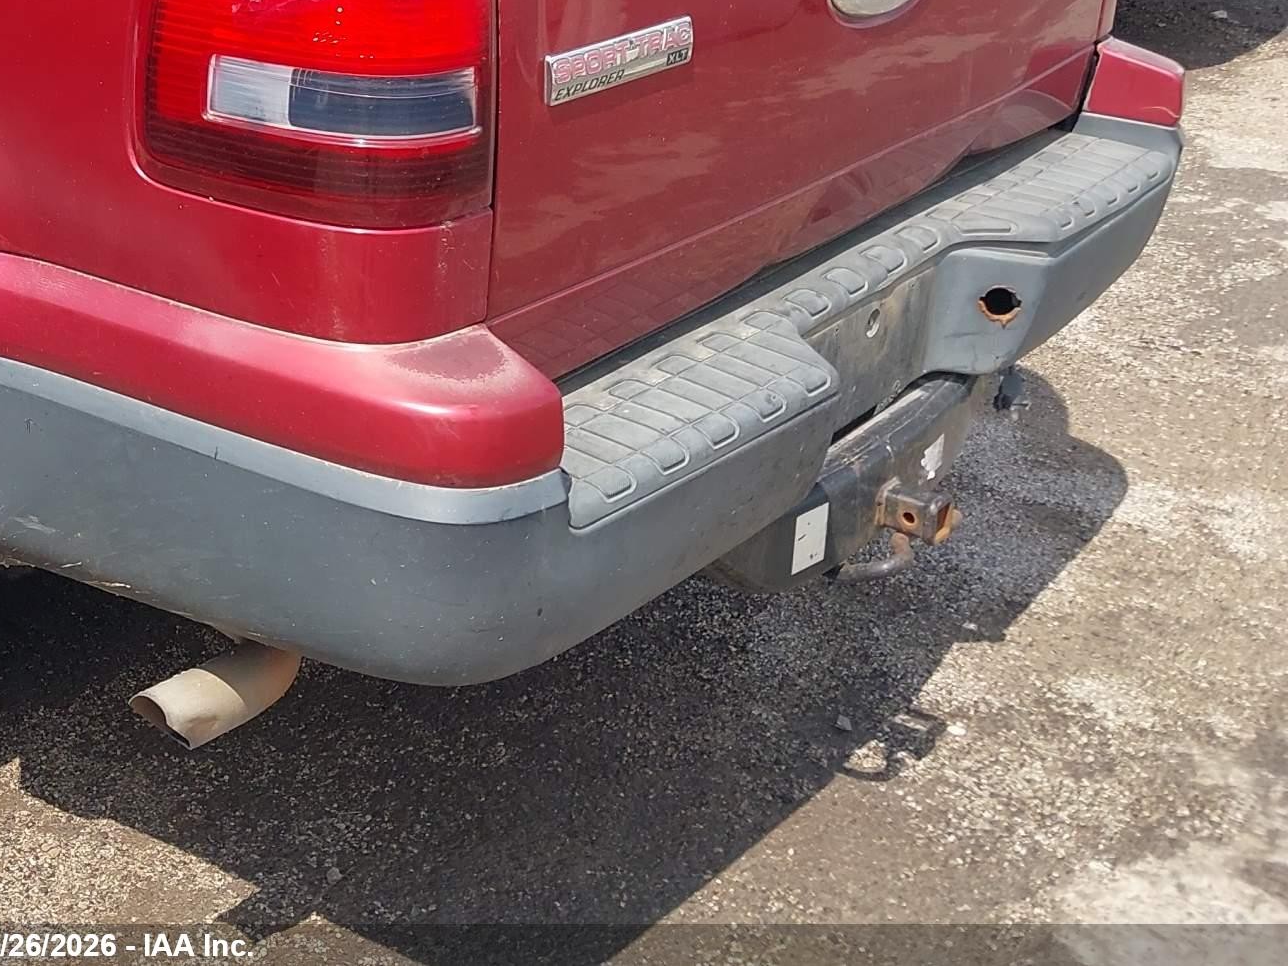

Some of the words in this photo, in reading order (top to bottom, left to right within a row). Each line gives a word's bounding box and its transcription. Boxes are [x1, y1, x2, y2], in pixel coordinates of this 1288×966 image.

[551, 38, 631, 84] SPORT
[633, 21, 691, 59] TRAC
[667, 48, 689, 66] XLT
[554, 69, 625, 101] EXPLORER
